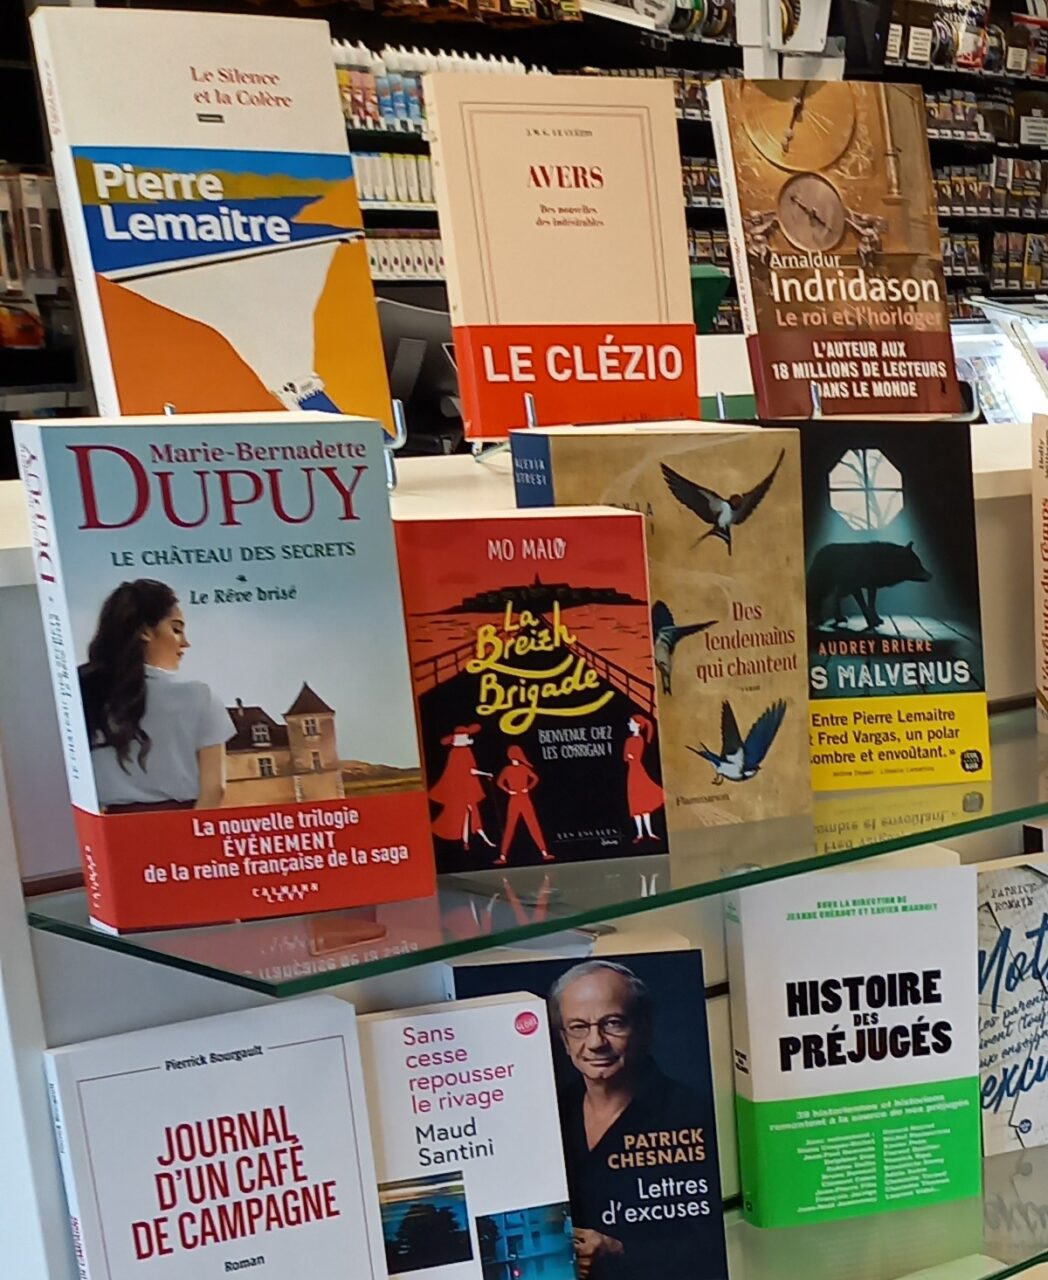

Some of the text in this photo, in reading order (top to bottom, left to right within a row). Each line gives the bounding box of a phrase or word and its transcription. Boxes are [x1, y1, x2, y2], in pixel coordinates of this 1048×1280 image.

[190, 66, 280, 86] Le Silence
[194, 89, 292, 108] et la Colère
[92, 162, 223, 201] Pierre
[527, 165, 604, 189] AVERS
[102, 205, 291, 243] Lemaitre
[770, 252, 841, 270] Arnaldur
[771, 270, 940, 303] Indridason
[482, 335, 683, 383] LE CLÉZIO
[813, 340, 906, 359] L'AUTEUR AUX
[772, 362, 947, 380] 18 MILLIONS DE LECTEURS
[853, 382, 875, 398] LE
[879, 381, 917, 398] MONDE
[149, 441, 366, 464] Marie-Bernadette
[66, 444, 369, 530] DUPUY
[112, 541, 356, 567] LE CHÂTEAU DES SECRETS
[504, 600, 539, 632] La
[732, 601, 762, 622] Des
[466, 600, 577, 679] Breizh
[703, 627, 795, 651] lendemains
[696, 652, 798, 683] qui chantent
[837, 660, 970, 689] MALVENUS
[475, 656, 614, 735] Brigade
[812, 708, 955, 727] Entre Pierre Lemaitre
[538, 725, 613, 744] BIENVENUE CHEZ
[818, 728, 959, 745] Fred Vargas, un polar
[541, 744, 605, 760] LES CORRIGAN
[193, 807, 359, 838] La nouvelle trilogie
[144, 845, 408, 883] de la reine française de la saga
[817, 895, 907, 909] SOUS LA DIRECTION DE
[786, 969, 942, 1018] HISTOIRE
[853, 1012, 879, 1026] DES
[403, 1025, 455, 1046] Sans
[778, 1015, 953, 1072] PRÉJUGÉS
[405, 1049, 468, 1069] cesse
[408, 1062, 515, 1092] repousser
[411, 1086, 505, 1114] le rivage
[157, 1105, 300, 1167] JOURNAL
[415, 1117, 478, 1144] Maud
[624, 1128, 704, 1150] PATRICK
[418, 1140, 495, 1167] Santini
[607, 1147, 706, 1170] CHESNAIS
[154, 1133, 309, 1211] D'UN CAFÉ
[638, 1178, 709, 1201] Lettres
[132, 1181, 341, 1260] DE CAMPAGNE
[602, 1201, 712, 1226] d'excuses
[224, 1254, 265, 1274] Roman
